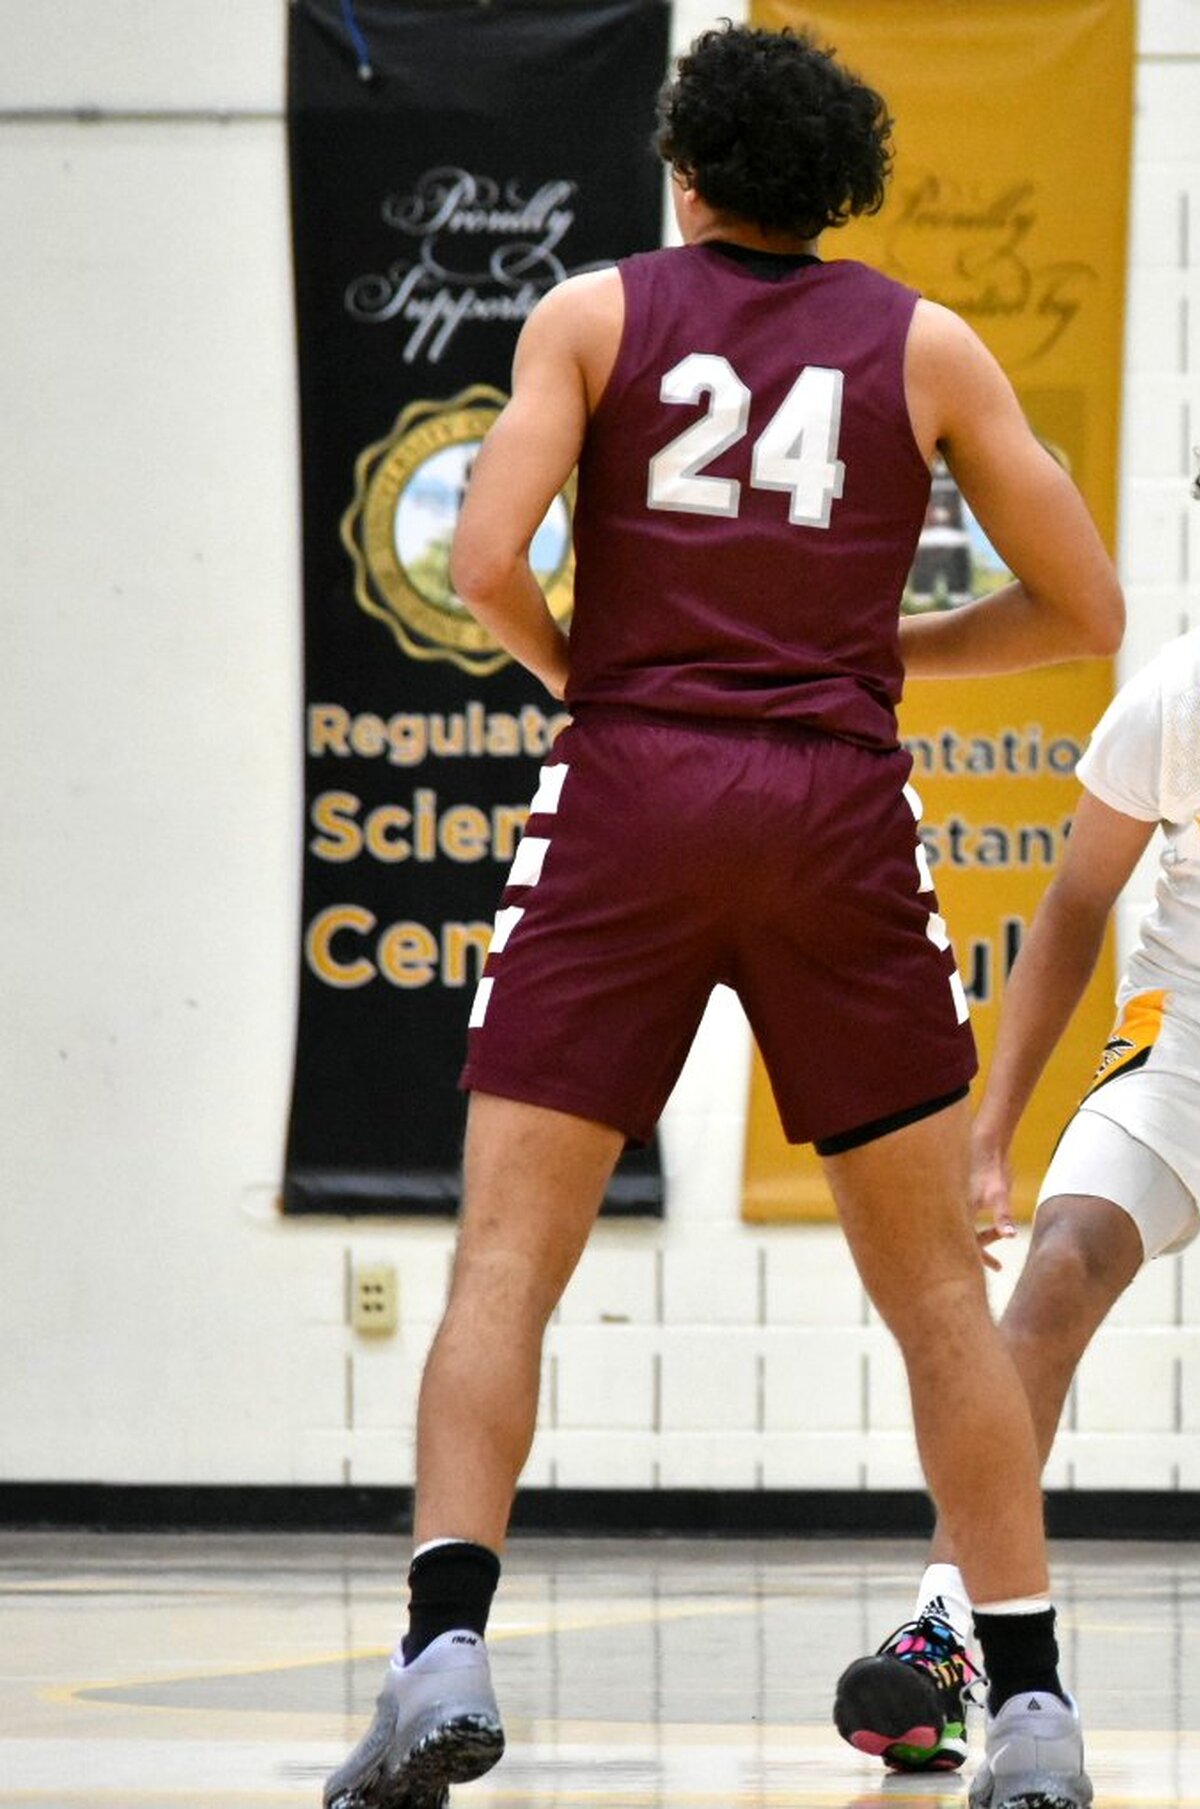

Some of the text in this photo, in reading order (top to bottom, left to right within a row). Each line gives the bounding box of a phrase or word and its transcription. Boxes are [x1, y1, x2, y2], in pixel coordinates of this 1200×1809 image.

[382, 166, 579, 285] Proudly
[647, 352, 846, 529] 24
[917, 817, 1073, 868] stan
